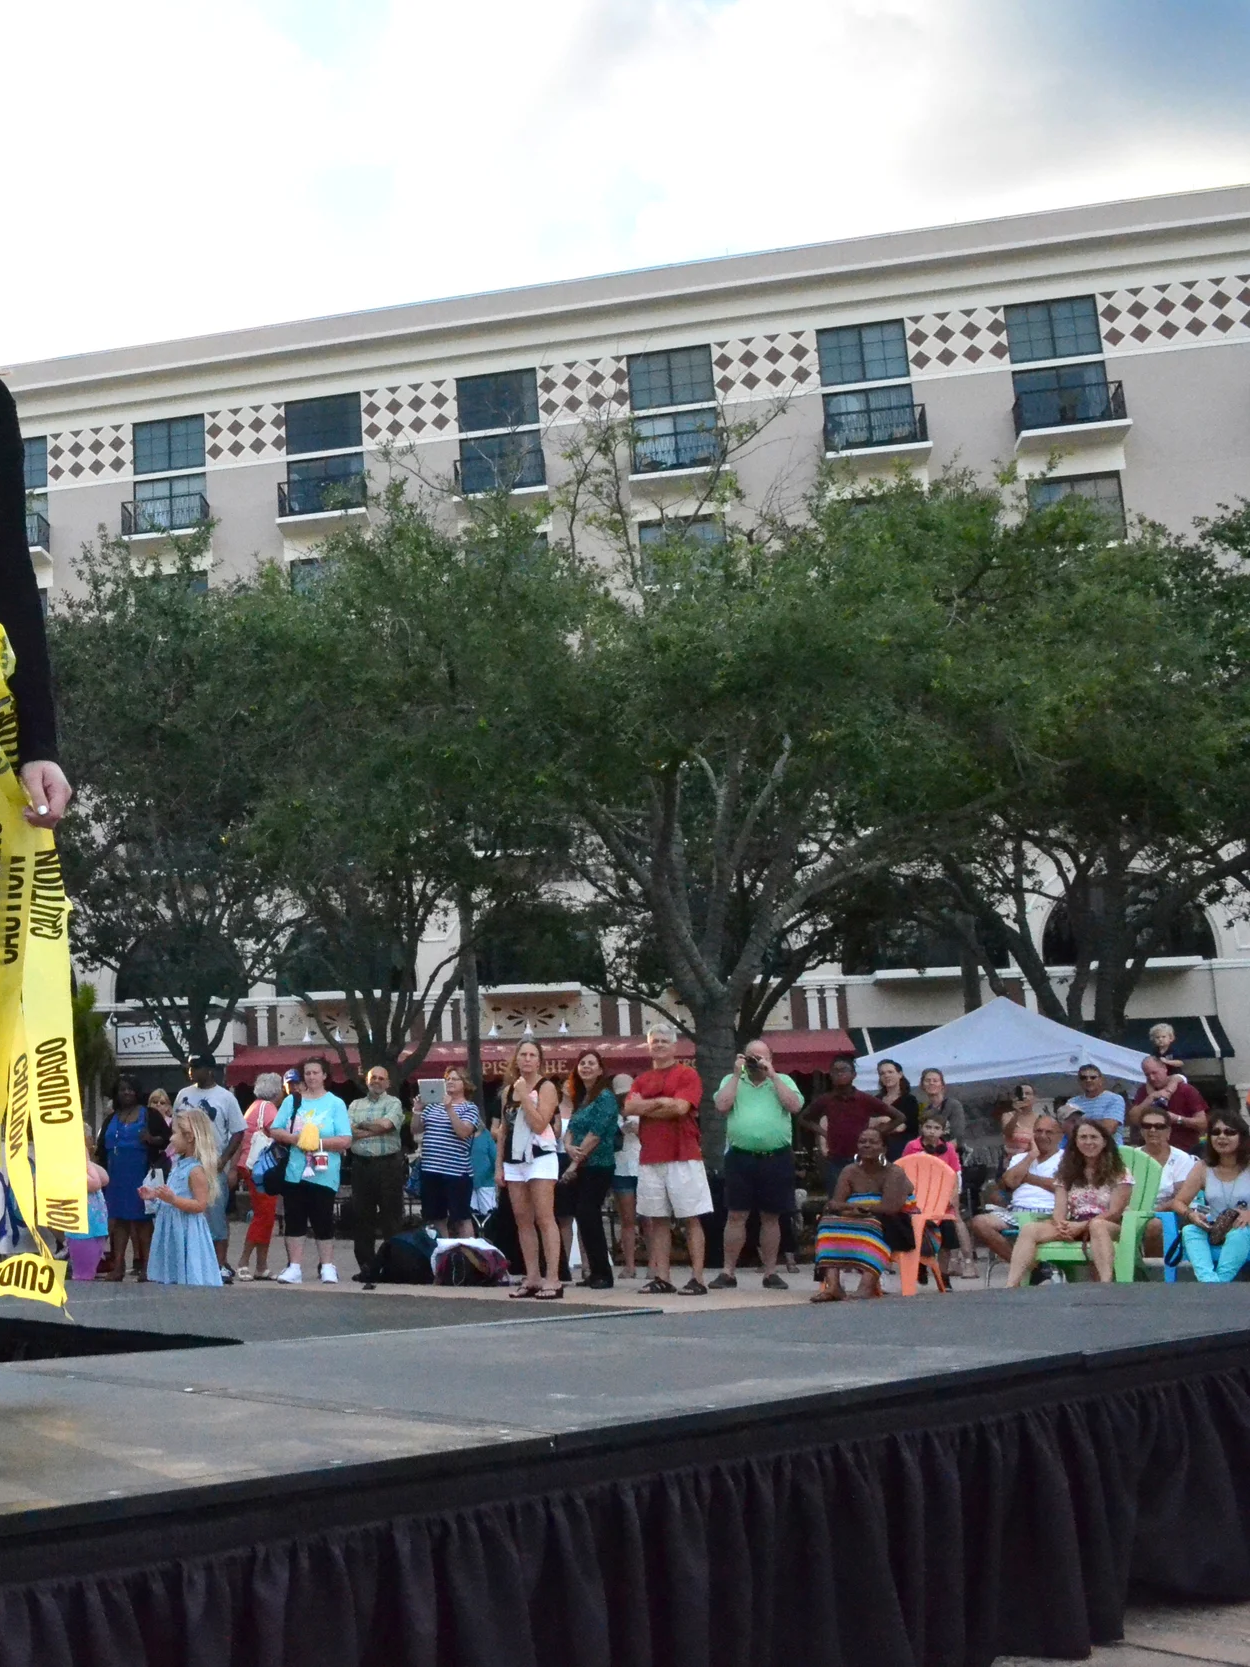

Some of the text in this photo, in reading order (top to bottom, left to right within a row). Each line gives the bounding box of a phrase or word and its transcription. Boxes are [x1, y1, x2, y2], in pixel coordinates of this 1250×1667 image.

[30, 848, 66, 940] CAUTION
[34, 1037, 74, 1125] CUIDADO
[45, 1197, 80, 1231] ION
